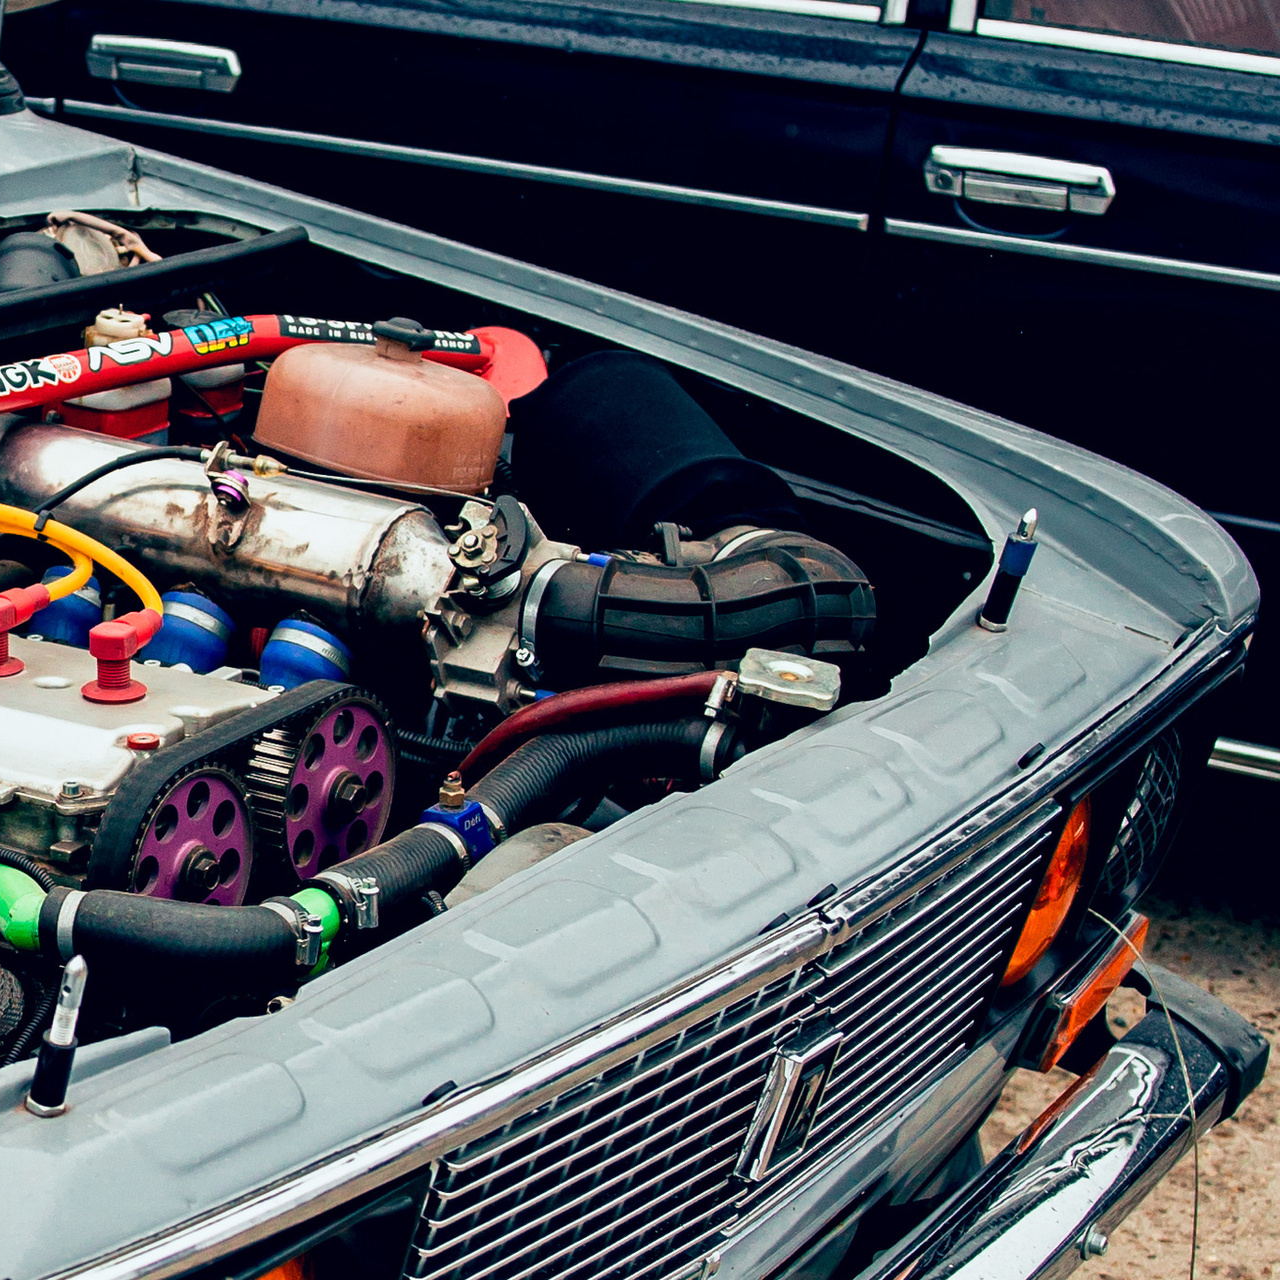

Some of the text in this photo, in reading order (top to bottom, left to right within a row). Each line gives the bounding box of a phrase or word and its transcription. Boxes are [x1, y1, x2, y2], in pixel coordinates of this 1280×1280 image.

[288, 324, 320, 336] MADE
[328, 329, 342, 338] IN
[349, 331, 378, 341] RUS
[464, 812, 481, 832] Defi
